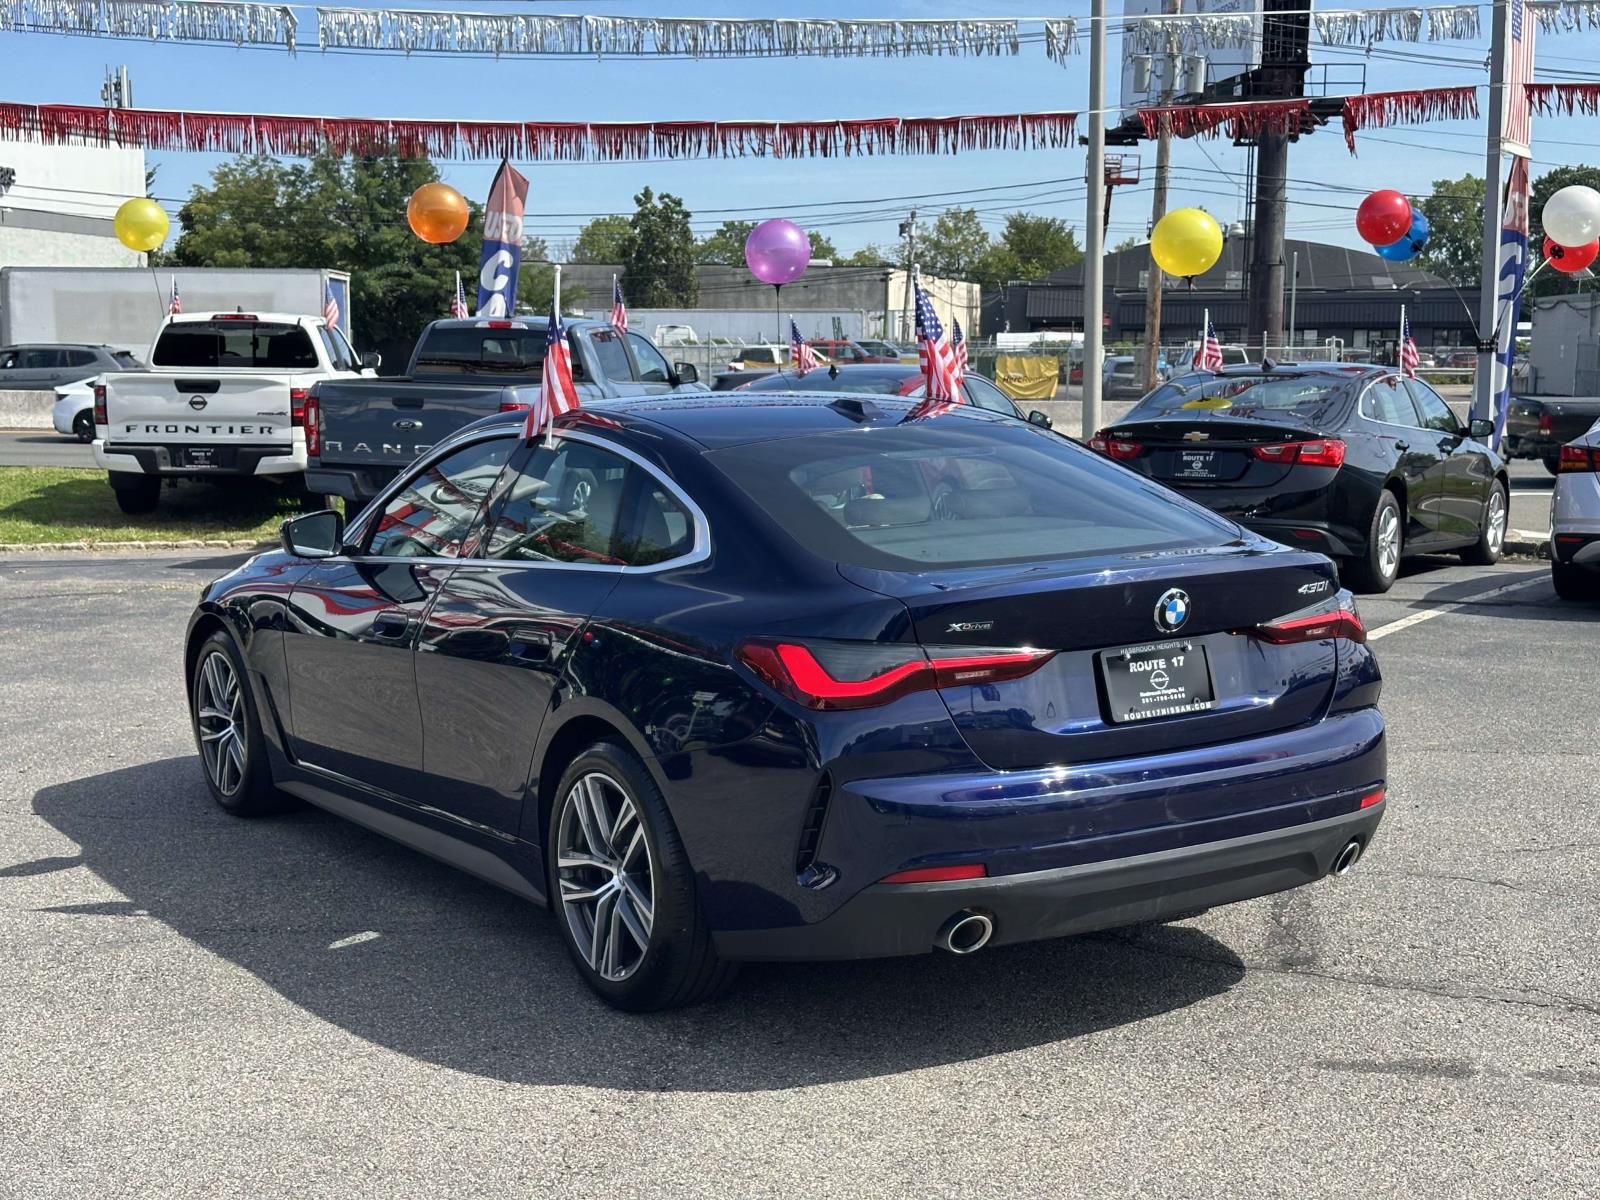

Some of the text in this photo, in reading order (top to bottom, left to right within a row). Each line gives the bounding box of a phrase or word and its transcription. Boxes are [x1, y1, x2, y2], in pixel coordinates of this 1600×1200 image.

[126, 425, 273, 435] FRONTIER
[1120, 644, 1155, 656] HASBROUCK
[1129, 655, 1185, 673] ROUTE 17
[1123, 701, 1212, 720] ROUTE17NISSAN.COM
